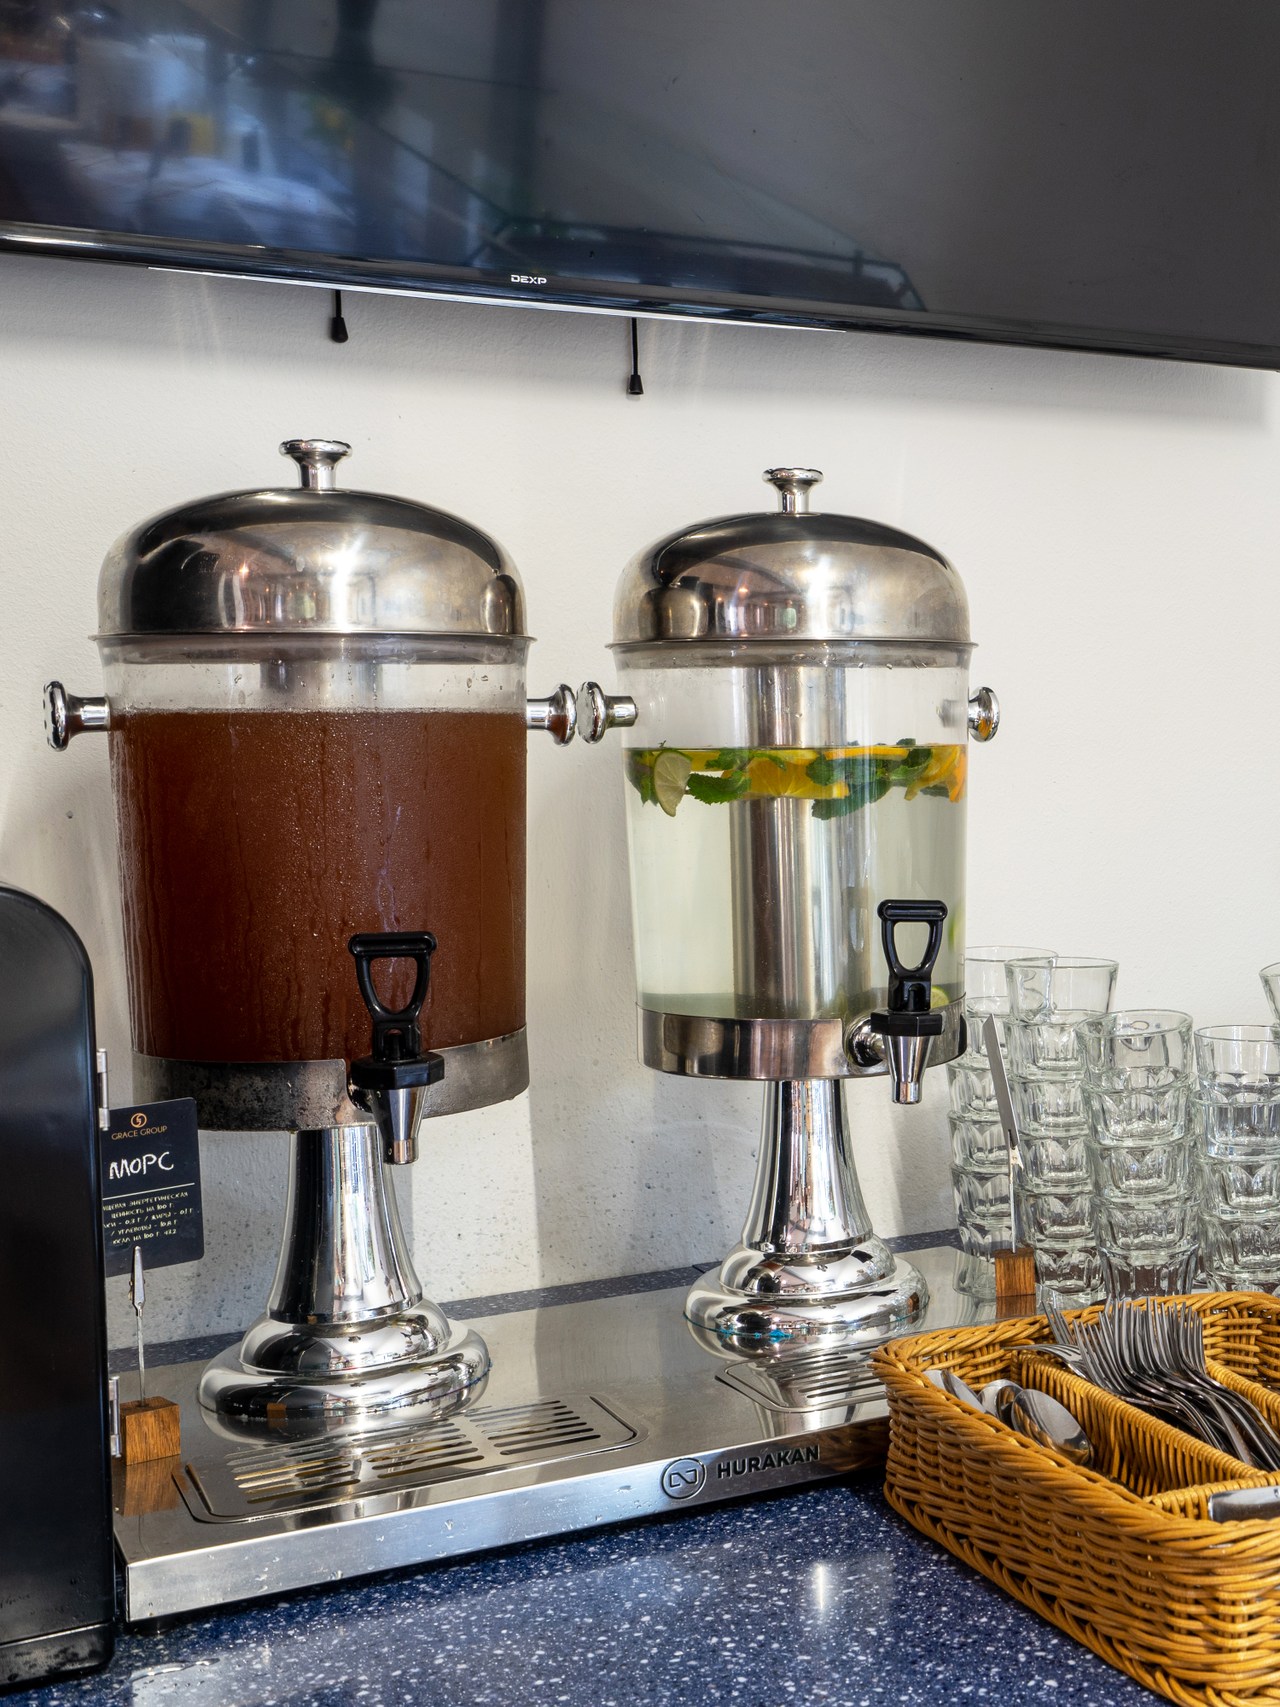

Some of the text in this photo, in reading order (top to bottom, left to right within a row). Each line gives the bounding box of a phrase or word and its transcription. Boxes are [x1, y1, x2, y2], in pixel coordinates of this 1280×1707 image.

[510, 274, 547, 285] DEXP
[111, 1126, 168, 1140] GRACE GROUP
[109, 1152, 174, 1180] МОРС
[111, 1208, 144, 1218] ЦЕННОСТЬ
[717, 1444, 820, 1480] HURAKAN
